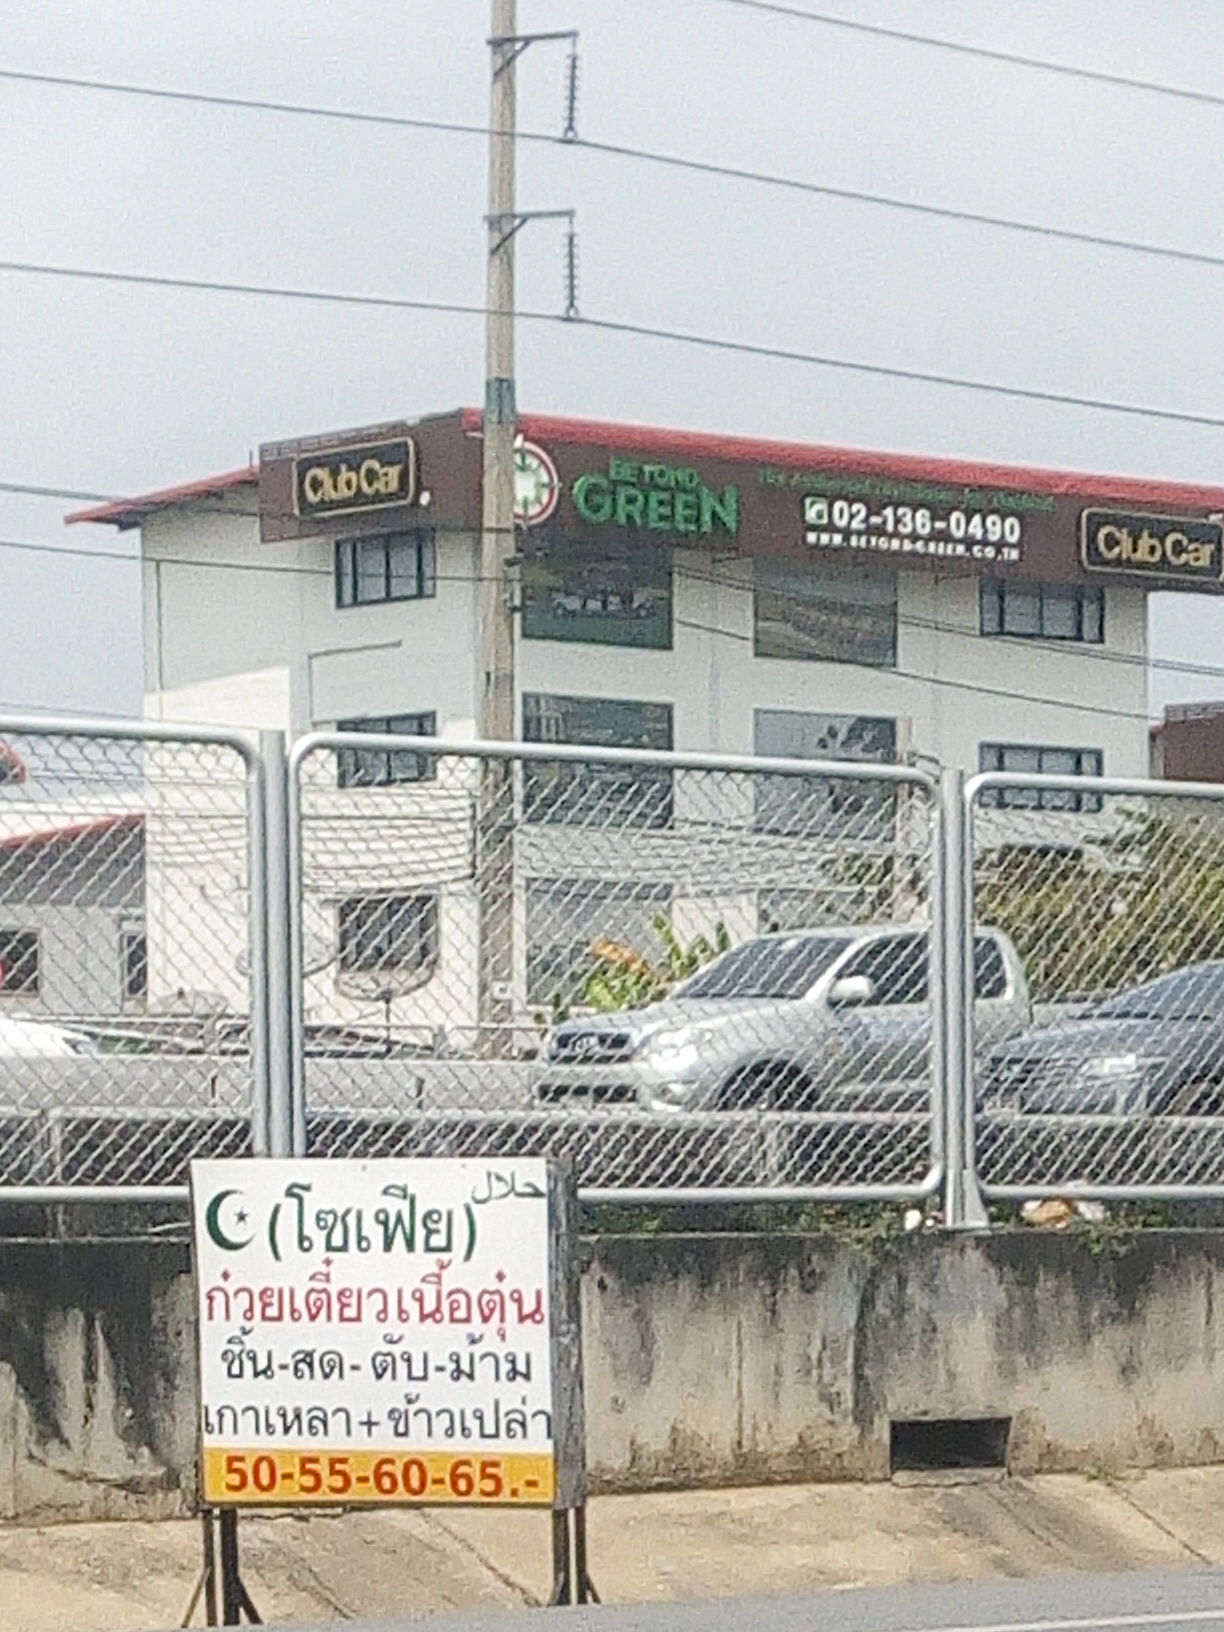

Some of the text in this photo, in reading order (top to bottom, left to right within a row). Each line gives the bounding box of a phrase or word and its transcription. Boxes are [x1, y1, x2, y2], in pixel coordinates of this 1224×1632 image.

[304, 459, 402, 503] Club Car
[573, 473, 739, 534] GREEN
[832, 499, 1021, 543] 02-136-0490
[1097, 525, 1215, 568] Club Car
[471, 1170, 546, 1204] حلال
[268, 1181, 477, 1262] (โซเฟีย)
